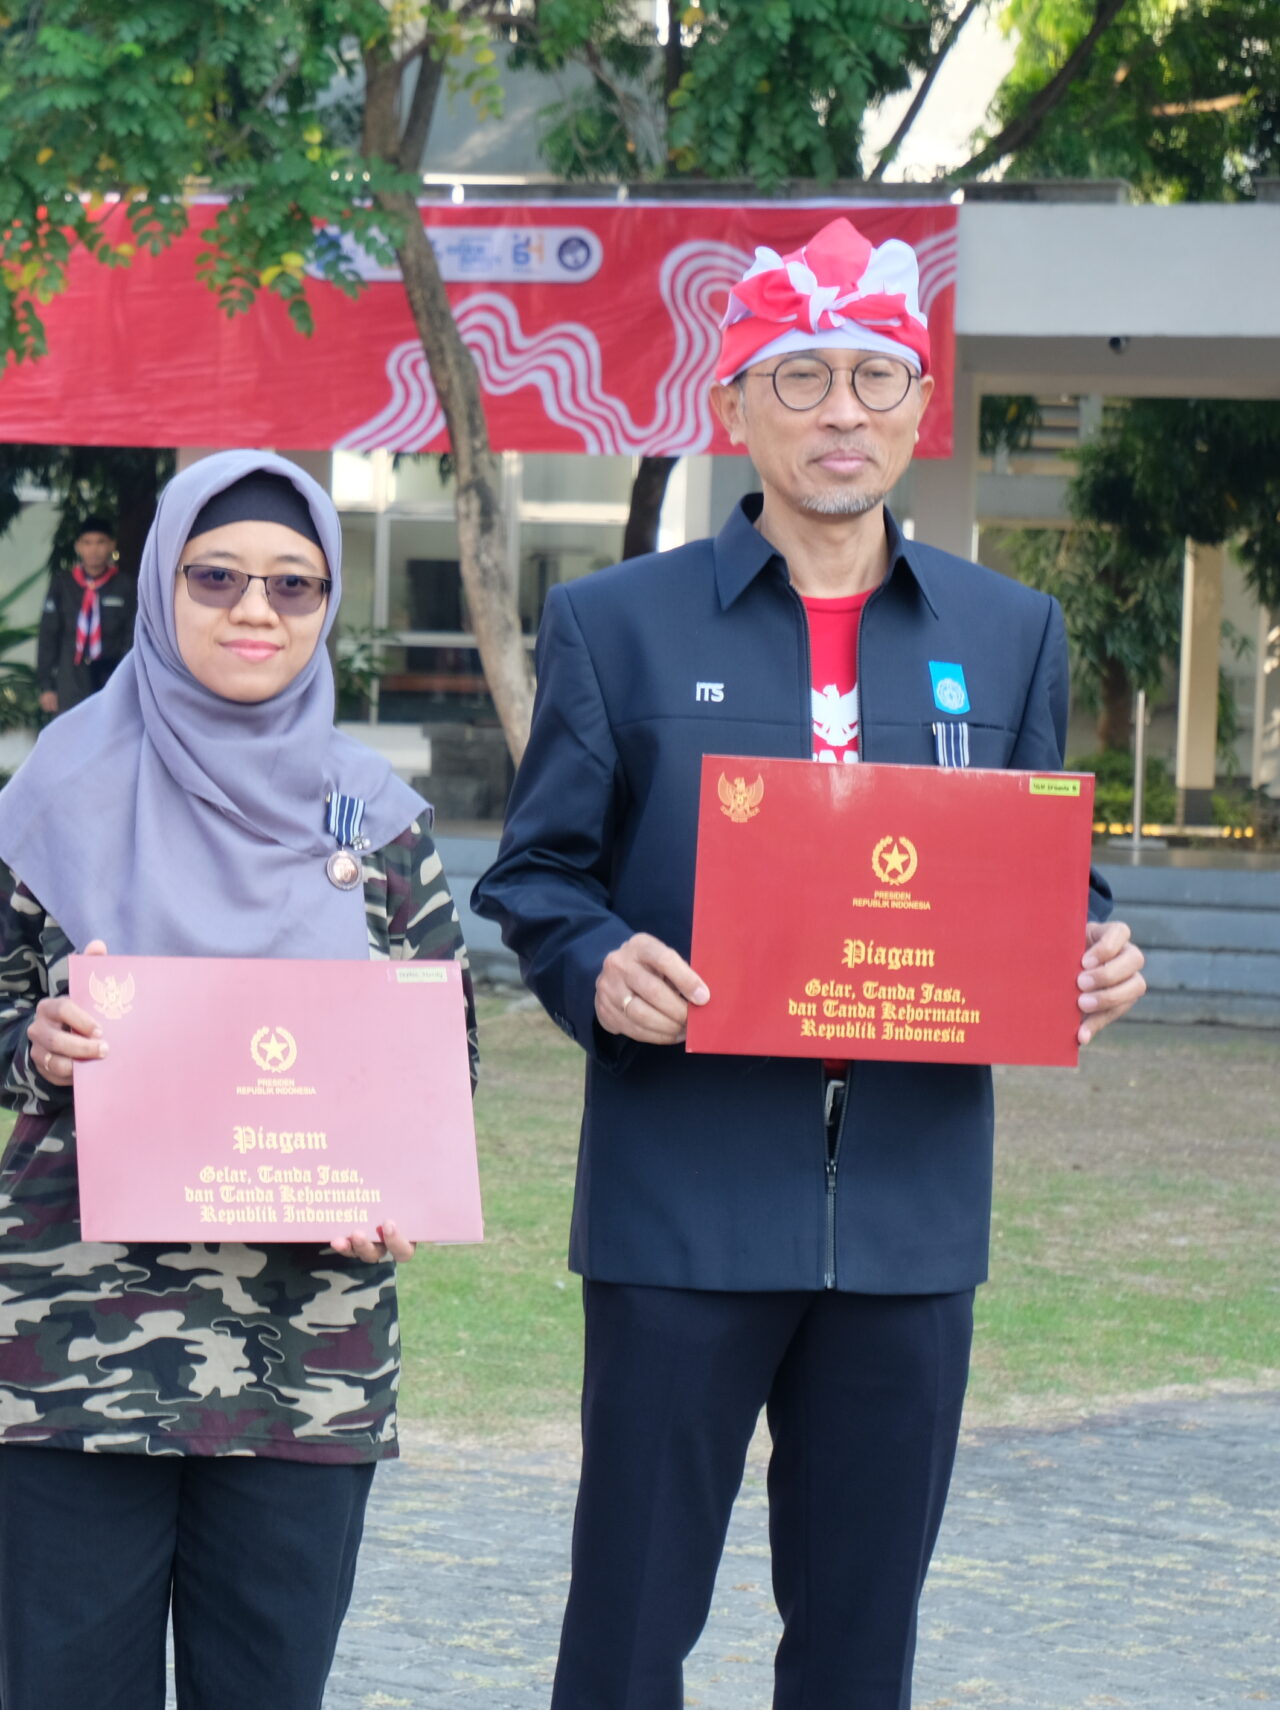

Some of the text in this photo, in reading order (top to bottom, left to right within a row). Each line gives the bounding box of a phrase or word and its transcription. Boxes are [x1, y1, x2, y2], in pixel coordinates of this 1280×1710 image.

[696, 681, 724, 702] ITS
[852, 897, 931, 910] REPUBLIK INDONESIA
[874, 890, 911, 900] PRESIDEN
[841, 938, 935, 970] Piagam
[805, 978, 966, 1005] Gelar, Tanda Jasa,
[788, 998, 980, 1024] dan Tanda Kehormatan
[800, 1018, 965, 1043] Republik Indonesia
[236, 1086, 317, 1095] REPUBLIK INDONESIA
[257, 1078, 295, 1087] PRESIDEN
[232, 1125, 328, 1154] Piagam
[199, 1165, 364, 1185] Gelar, Tanda Jasa,
[184, 1184, 381, 1205] dan Tanda Kehormatan
[200, 1204, 368, 1225] Republik Indonesia
